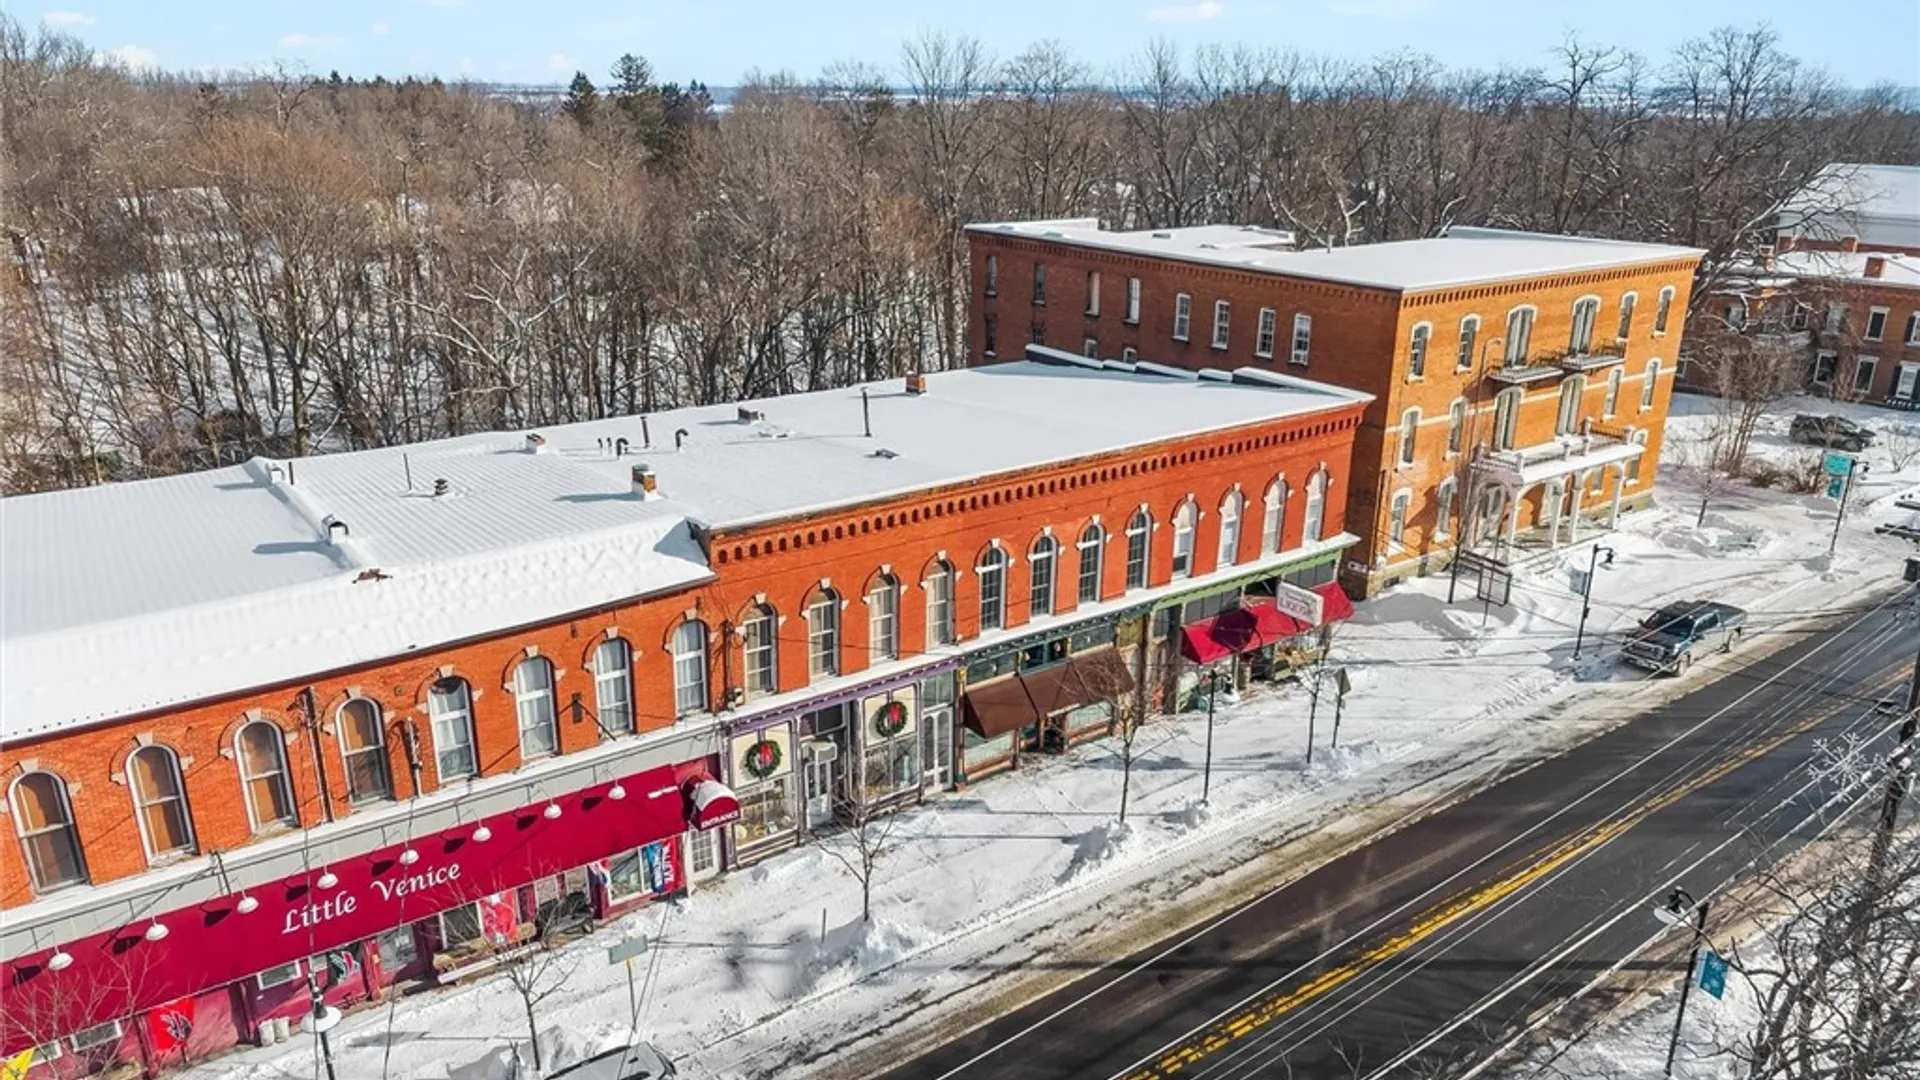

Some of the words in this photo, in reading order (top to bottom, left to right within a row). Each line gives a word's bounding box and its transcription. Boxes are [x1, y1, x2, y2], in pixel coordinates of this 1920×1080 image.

[701, 810, 738, 829] ENTRANCE
[281, 890, 357, 934] Little
[370, 863, 461, 901] Venice
